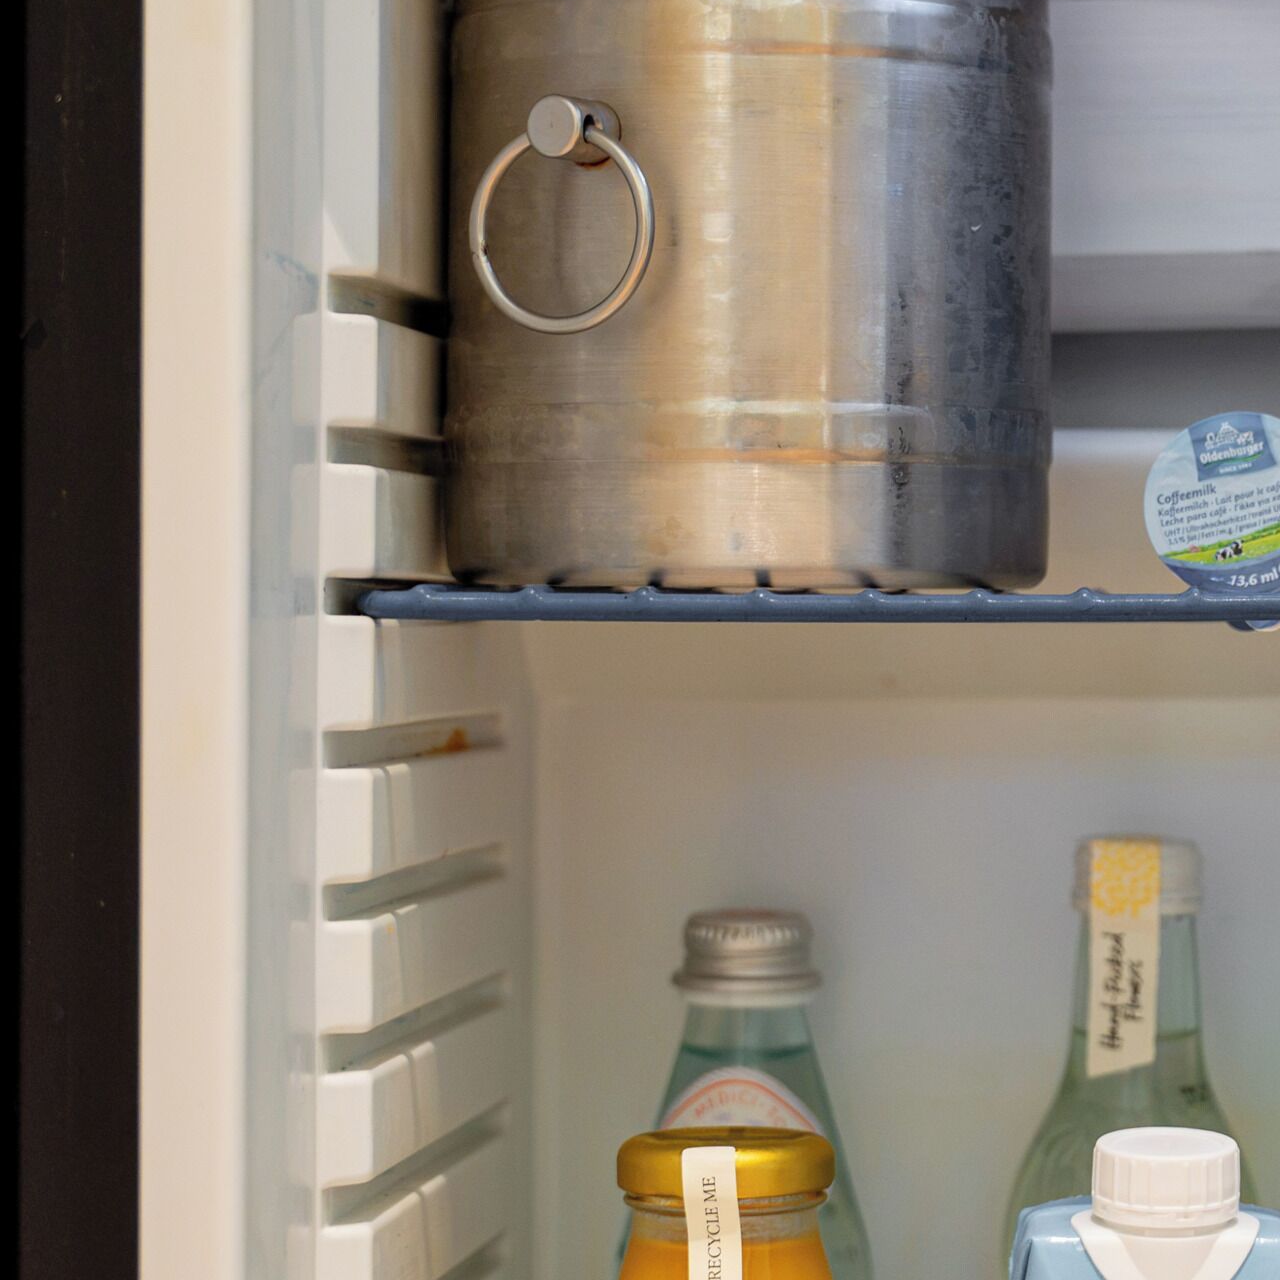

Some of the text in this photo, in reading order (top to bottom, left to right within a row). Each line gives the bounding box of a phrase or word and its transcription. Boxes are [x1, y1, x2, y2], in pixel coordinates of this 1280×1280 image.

[1200, 441, 1264, 464] Oldenburger
[1157, 484, 1216, 507] Coffeemilk
[1158, 501, 1208, 518] Kaffeemilch
[1161, 512, 1184, 527] Leche
[1230, 574, 1258, 588] 13,6
[1261, 567, 1279, 584] ml
[702, 1176, 718, 1203] ME
